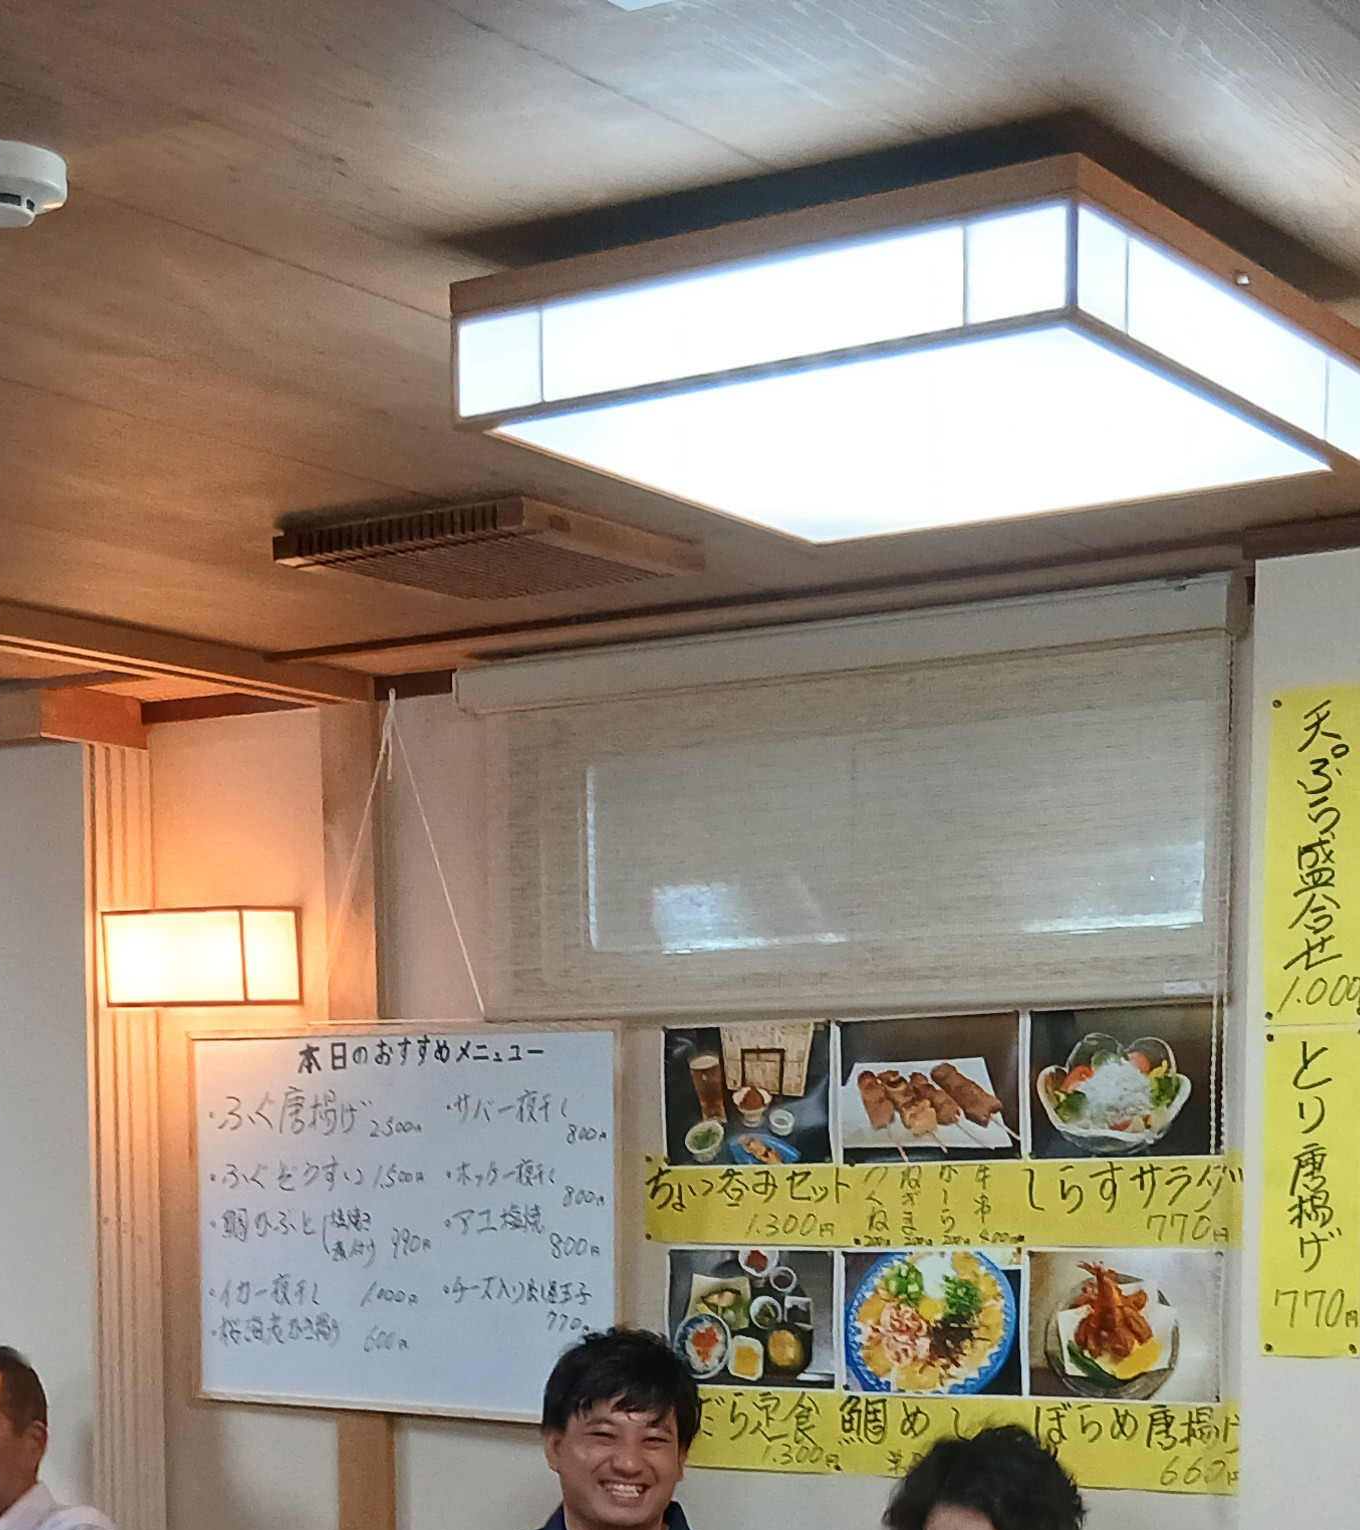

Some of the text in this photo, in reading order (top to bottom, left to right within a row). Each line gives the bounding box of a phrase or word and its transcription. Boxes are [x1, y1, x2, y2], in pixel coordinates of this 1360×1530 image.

[1283, 699, 1350, 971] 天ぷら盛合せ
[298, 1034, 544, 1074] 本日のおすすめメニュー
[1287, 1040, 1342, 1273] とり唐揚げ
[1020, 1161, 1244, 1215] しらすサラダ
[1146, 1213, 1230, 1244] 770円
[1273, 1287, 1360, 1329] 770円
[838, 1395, 974, 1446] 鯛めし
